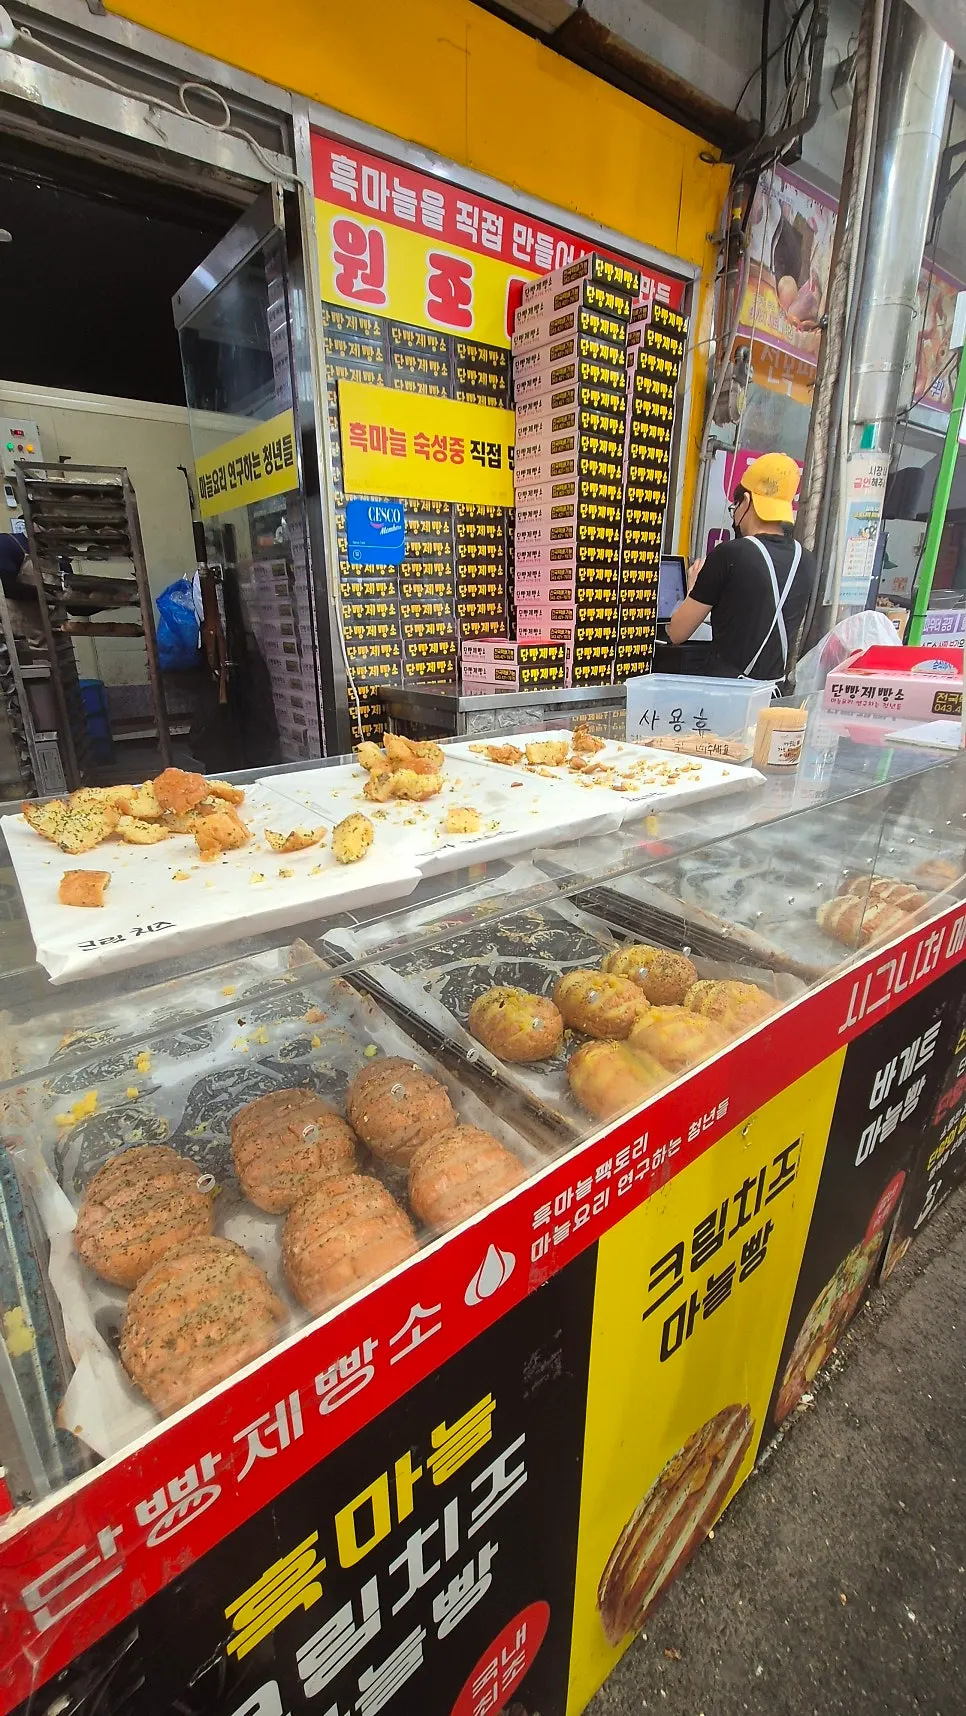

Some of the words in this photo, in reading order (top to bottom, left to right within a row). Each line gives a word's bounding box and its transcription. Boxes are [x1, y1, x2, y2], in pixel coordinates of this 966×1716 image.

[329, 152, 446, 232] 흑마늘을
[456, 200, 504, 251] 직접
[512, 222, 588, 270] 만들어
[595, 258, 639, 290] 단빵제빵소
[586, 284, 630, 315] 단빵제빵소
[580, 311, 625, 340] 단빵제빵소
[654, 302, 688, 332] 단빵제빵소
[580, 338, 625, 366] 단빵제빵소
[647, 328, 683, 356] 단빵제빵소
[640, 351, 678, 376] 단빵제빵소
[581, 363, 626, 390] 단빵제빵소
[636, 375, 673, 399] 단빵제빵소
[581, 388, 625, 411] 단빵제빵소
[635, 398, 672, 420] 단빵제빵소
[581, 411, 624, 435] 단빵제빵소
[632, 421, 670, 442] 단빵제빵소
[349, 422, 407, 458] 흑마늘
[413, 432, 465, 465] 숙성중
[470, 440, 502, 469] 직접
[580, 435, 623, 458] 단빵제빵소
[631, 443, 669, 463] 단빵제빵소
[199, 466, 227, 499] 마늘요리
[228, 452, 261, 489] 연구하는
[262, 434, 293, 475] 청년들
[580, 458, 622, 479] 단빵제빵소
[630, 465, 668, 484] 단빵제빵소
[581, 481, 622, 501] 단빵제빵소
[628, 487, 666, 505] 단빵제빵소
[368, 506, 400, 523] CESCO
[580, 503, 620, 521] 단빵제빵소
[626, 508, 662, 524] 단빵제빵소
[579, 525, 619, 543] 단빵제빵소
[625, 530, 660, 546] 단빵제빵소
[579, 547, 619, 564] 단빵제빵소
[624, 549, 660, 564] 단빵제빵소
[578, 567, 618, 584] 단빵제빵소
[622, 570, 658, 583] 단빵제빵소
[577, 588, 617, 603] 단빵제빵소
[620, 589, 656, 602] 단빵제빵소
[578, 608, 618, 622] 단빵제빵소
[622, 607, 656, 620] 단빵제빵소
[577, 626, 617, 641] 단빵제빵소
[620, 626, 654, 639] 단빵제빵소
[520, 647, 564, 662] 단빵제빵소
[576, 645, 614, 660] 단빵제빵소
[618, 643, 652, 657] 단빵제빵소
[521, 665, 564, 682] 단빵제빵소
[574, 662, 612, 679] 단빵제빵소
[616, 661, 649, 675] 단빵제빵소
[832, 684, 904, 702] 단빵제빵소
[936, 692, 963, 704] 전국
[76, 934, 126, 952] 크림
[129, 921, 176, 936] 치즈
[837, 926, 946, 1034] 시그니처
[869, 1020, 942, 1110] 바게트
[854, 1074, 926, 1167] 마늘빵
[530, 1190, 610, 1263] 마늘요리
[617, 1136, 682, 1197] 연구하는
[687, 1096, 730, 1142] 청년들
[532, 1132, 650, 1230] 흑마늘팩토리
[642, 1137, 801, 1322] 크림치즈
[659, 1218, 775, 1363] 마늘빵
[20, 1301, 443, 1632] 단빵제빵소
[224, 1392, 496, 1660] 흑마늘
[322, 1540, 498, 1716] 늘빵
[472, 1622, 527, 1699] 국내
